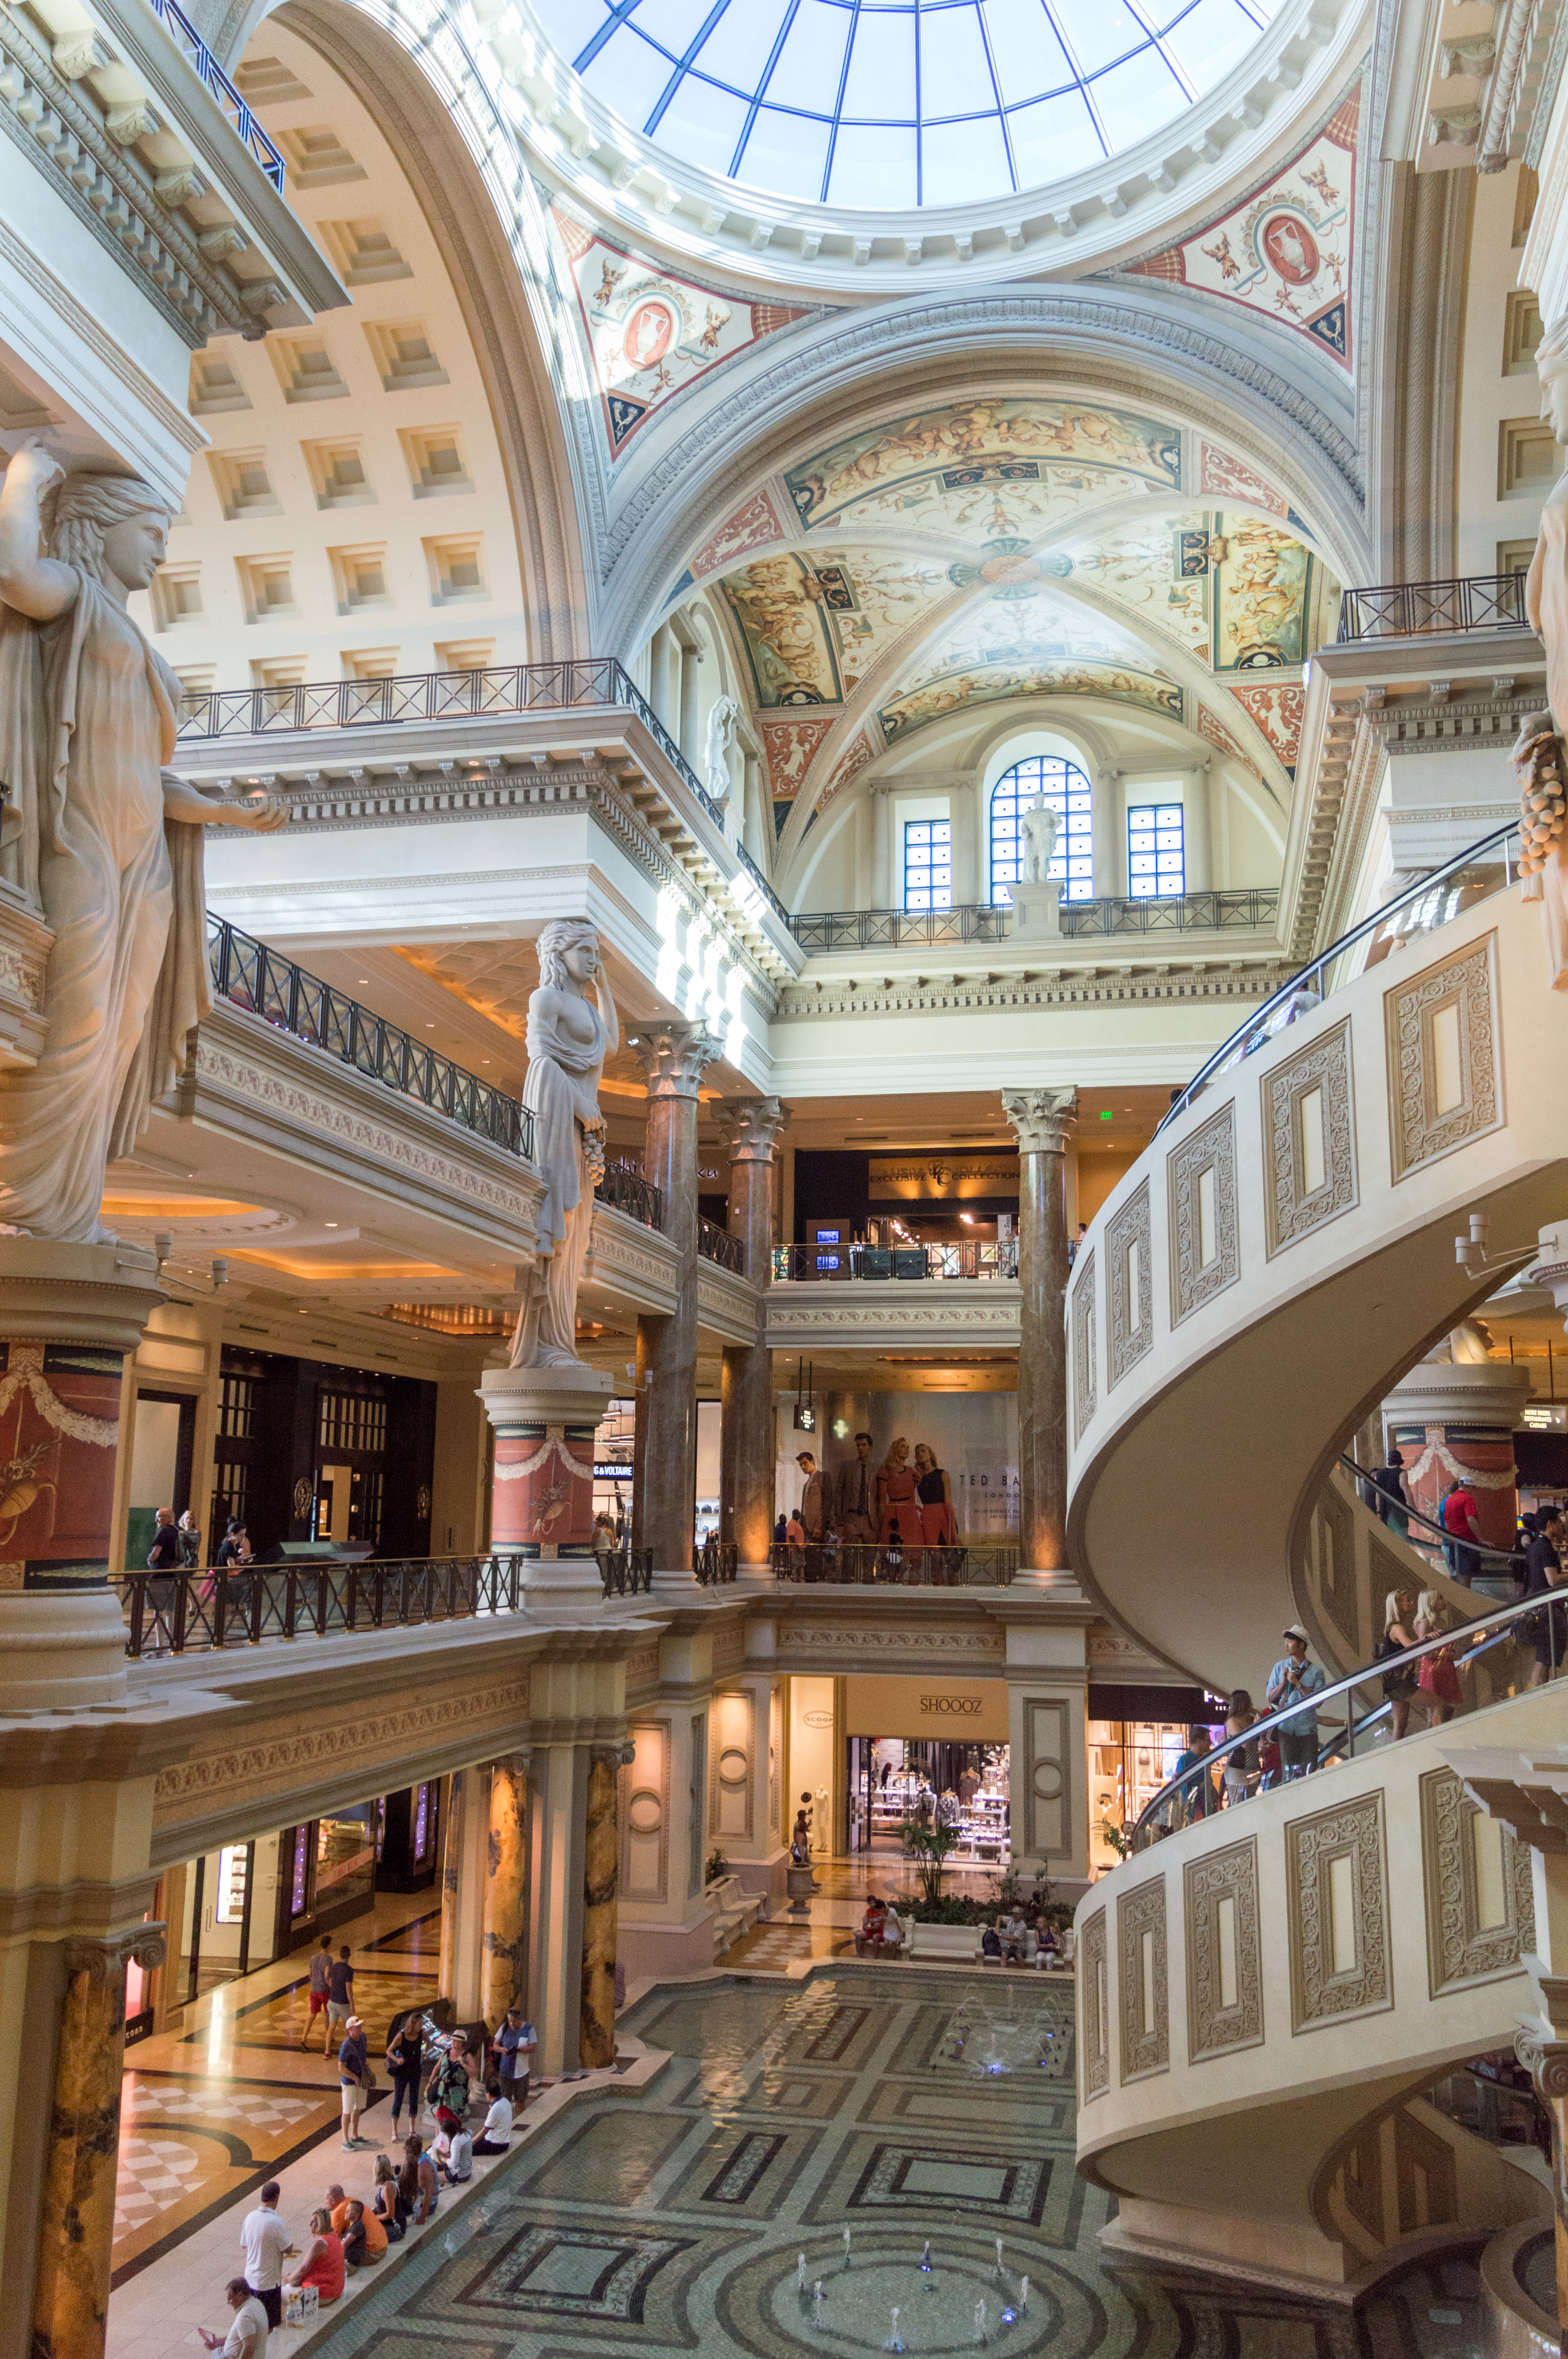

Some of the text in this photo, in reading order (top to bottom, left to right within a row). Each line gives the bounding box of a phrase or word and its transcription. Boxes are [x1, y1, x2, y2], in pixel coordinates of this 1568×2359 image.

[960, 1475, 1019, 1485] TED BA
[921, 1698, 982, 1713] SHOOOZ
